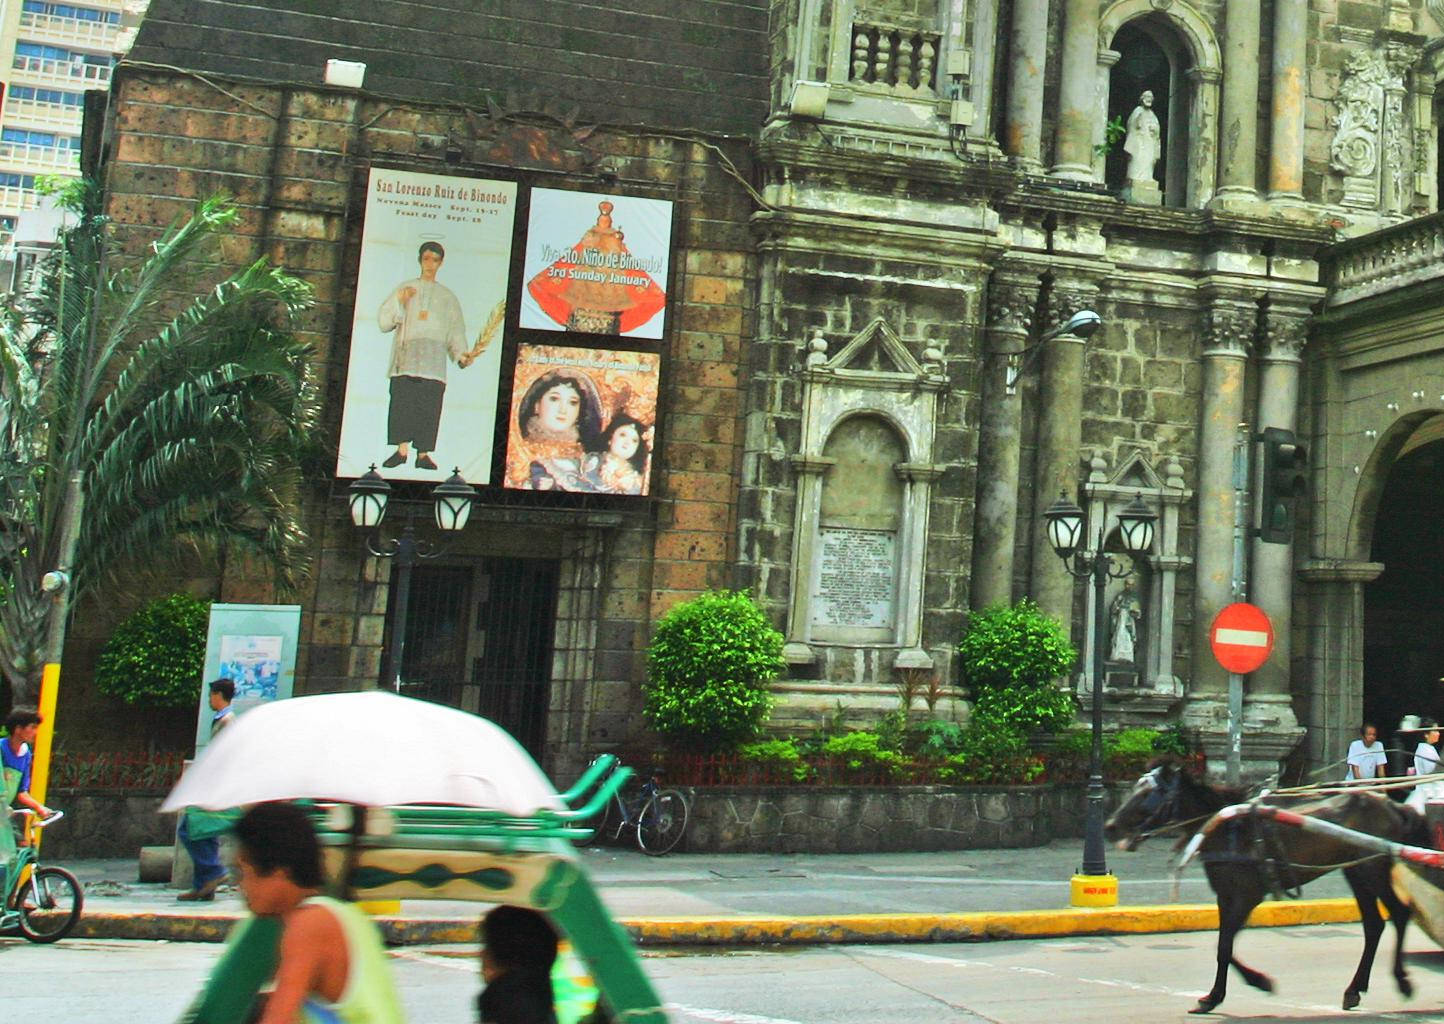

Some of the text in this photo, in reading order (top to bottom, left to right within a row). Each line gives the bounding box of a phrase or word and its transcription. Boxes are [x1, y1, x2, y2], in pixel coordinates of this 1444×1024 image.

[376, 179, 508, 205] San Lorenzo Ruiz de Binondo
[607, 249, 619, 268] de
[547, 266, 652, 288] 3rd Sunday January
